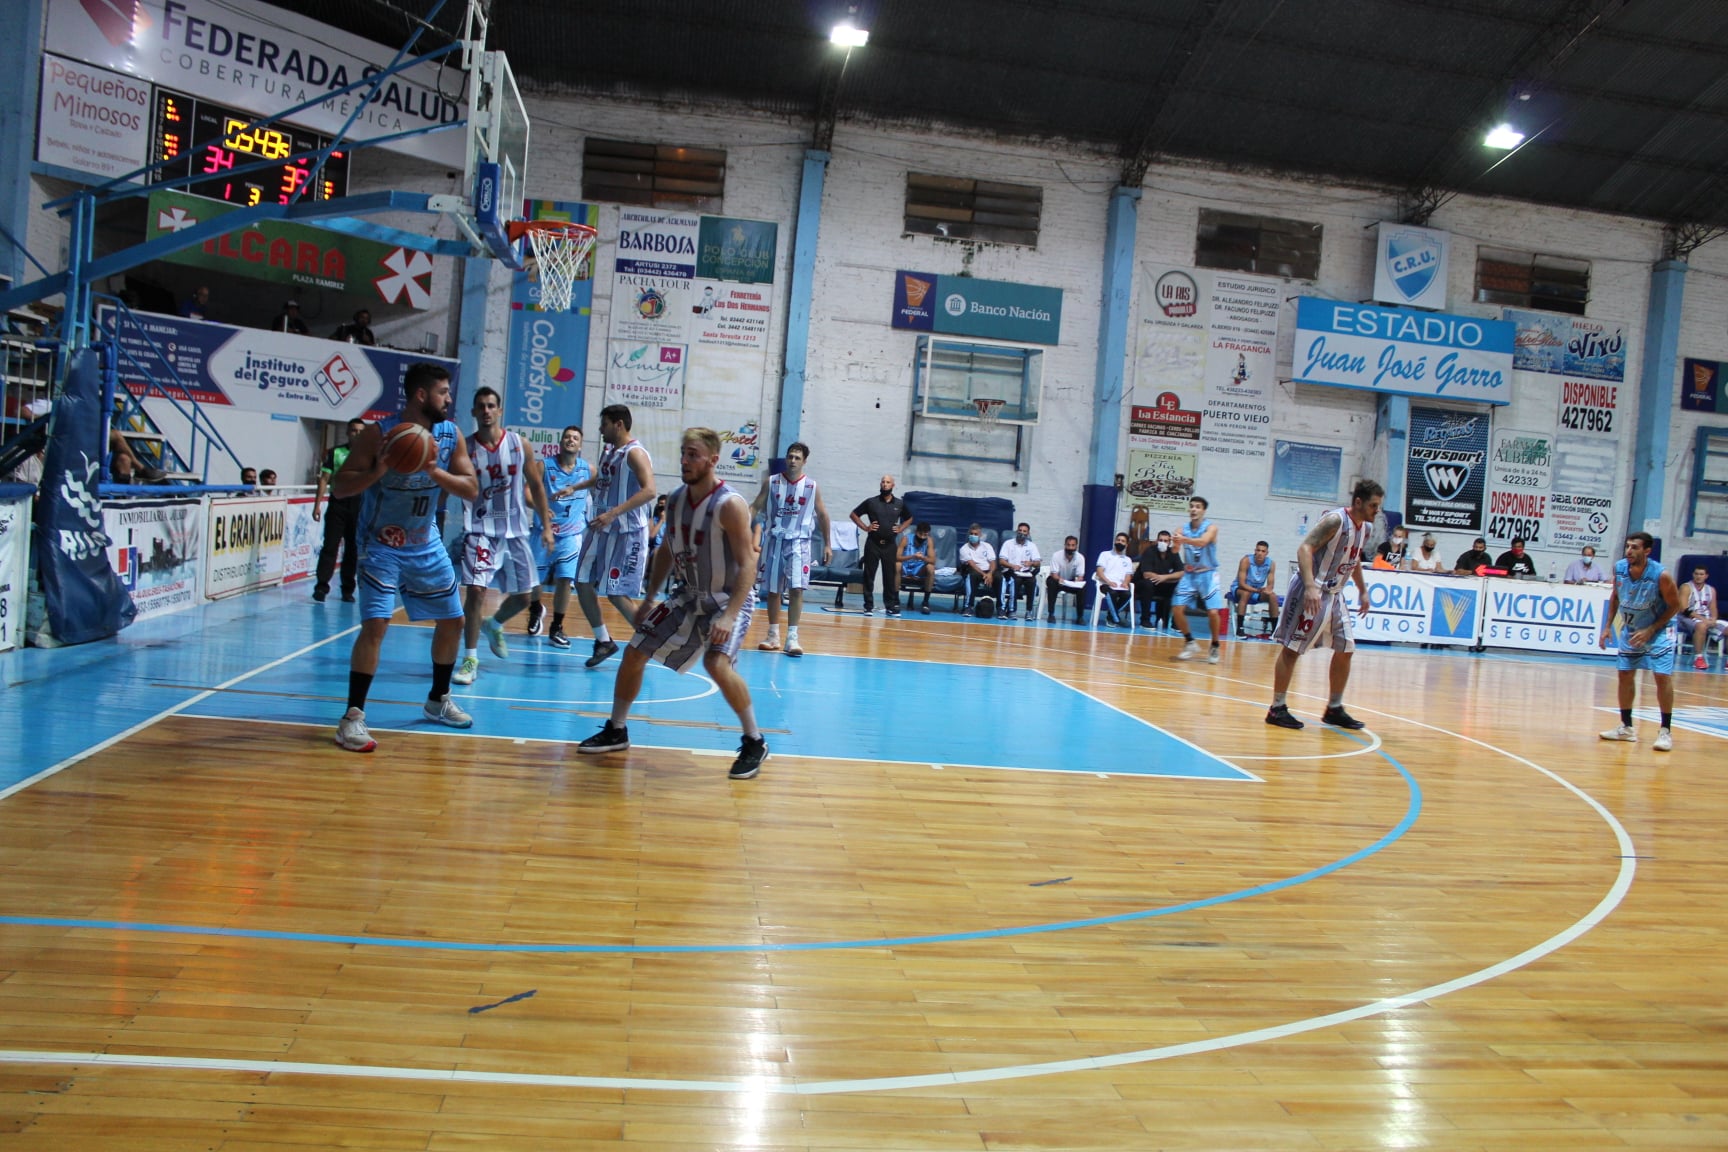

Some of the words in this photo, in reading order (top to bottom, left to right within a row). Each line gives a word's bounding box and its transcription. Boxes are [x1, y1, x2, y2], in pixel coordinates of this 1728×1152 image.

[162, 0, 351, 96] FEDERADA
[359, 66, 459, 123] SALUD
[50, 61, 147, 106] Pequeños
[160, 48, 306, 103] COBERTURA
[54, 91, 141, 131] Mimosos
[619, 230, 696, 256] BARBOSA
[202, 230, 345, 281] ILCARA
[1393, 251, 1436, 274] C.R.U.
[293, 273, 314, 285] PLAZA
[619, 275, 656, 288] PACHA
[660, 278, 691, 291] TOUR
[1217, 281, 1246, 291] ESTUDIO
[1161, 284, 1174, 299] LA
[1175, 285, 1191, 301] RIS
[1221, 296, 1254, 306] ALEJANDRO
[900, 308, 929, 318] FEDERAL
[970, 301, 1007, 316] Banco
[1008, 306, 1051, 322] Nación
[1224, 305, 1250, 314] FACUNDO
[1332, 306, 1483, 347] ESTADIO
[1212, 341, 1223, 349] LA
[1225, 342, 1272, 354] FRAGANCIA
[246, 350, 305, 374] instituto
[520, 319, 555, 425] Colorshop
[1302, 335, 1366, 378] Juan
[1372, 344, 1427, 386] José
[1434, 351, 1504, 394] Garro
[234, 367, 257, 381] del
[258, 371, 310, 390] Seguro
[610, 383, 632, 391] ROPA
[633, 385, 679, 395] DEPORTIVA
[1208, 400, 1266, 412] DEPARTAMENTOS
[1562, 382, 1617, 409] DISPONIBLE
[1138, 409, 1151, 419] La
[1152, 410, 1196, 423] Estancia
[1203, 409, 1241, 421] PUERTO
[1243, 413, 1270, 424] VIEJO
[1561, 406, 1613, 433] 427962
[528, 429, 553, 444] Julio
[1411, 447, 1484, 463] waysport
[1493, 447, 1551, 468] ALBERDI
[1502, 474, 1539, 487] 422332
[411, 495, 430, 517] 10
[1490, 490, 1546, 519] DISPONIBLE
[120, 510, 168, 526] INMOBILIARIA
[1488, 515, 1540, 542] 427962
[215, 516, 226, 551] EL
[230, 512, 256, 549] GRAN
[258, 510, 284, 545] POLLO
[1493, 591, 1596, 624] VICTORIA
[1350, 615, 1425, 634] GUROS
[1490, 624, 1595, 646] SEGUROS
